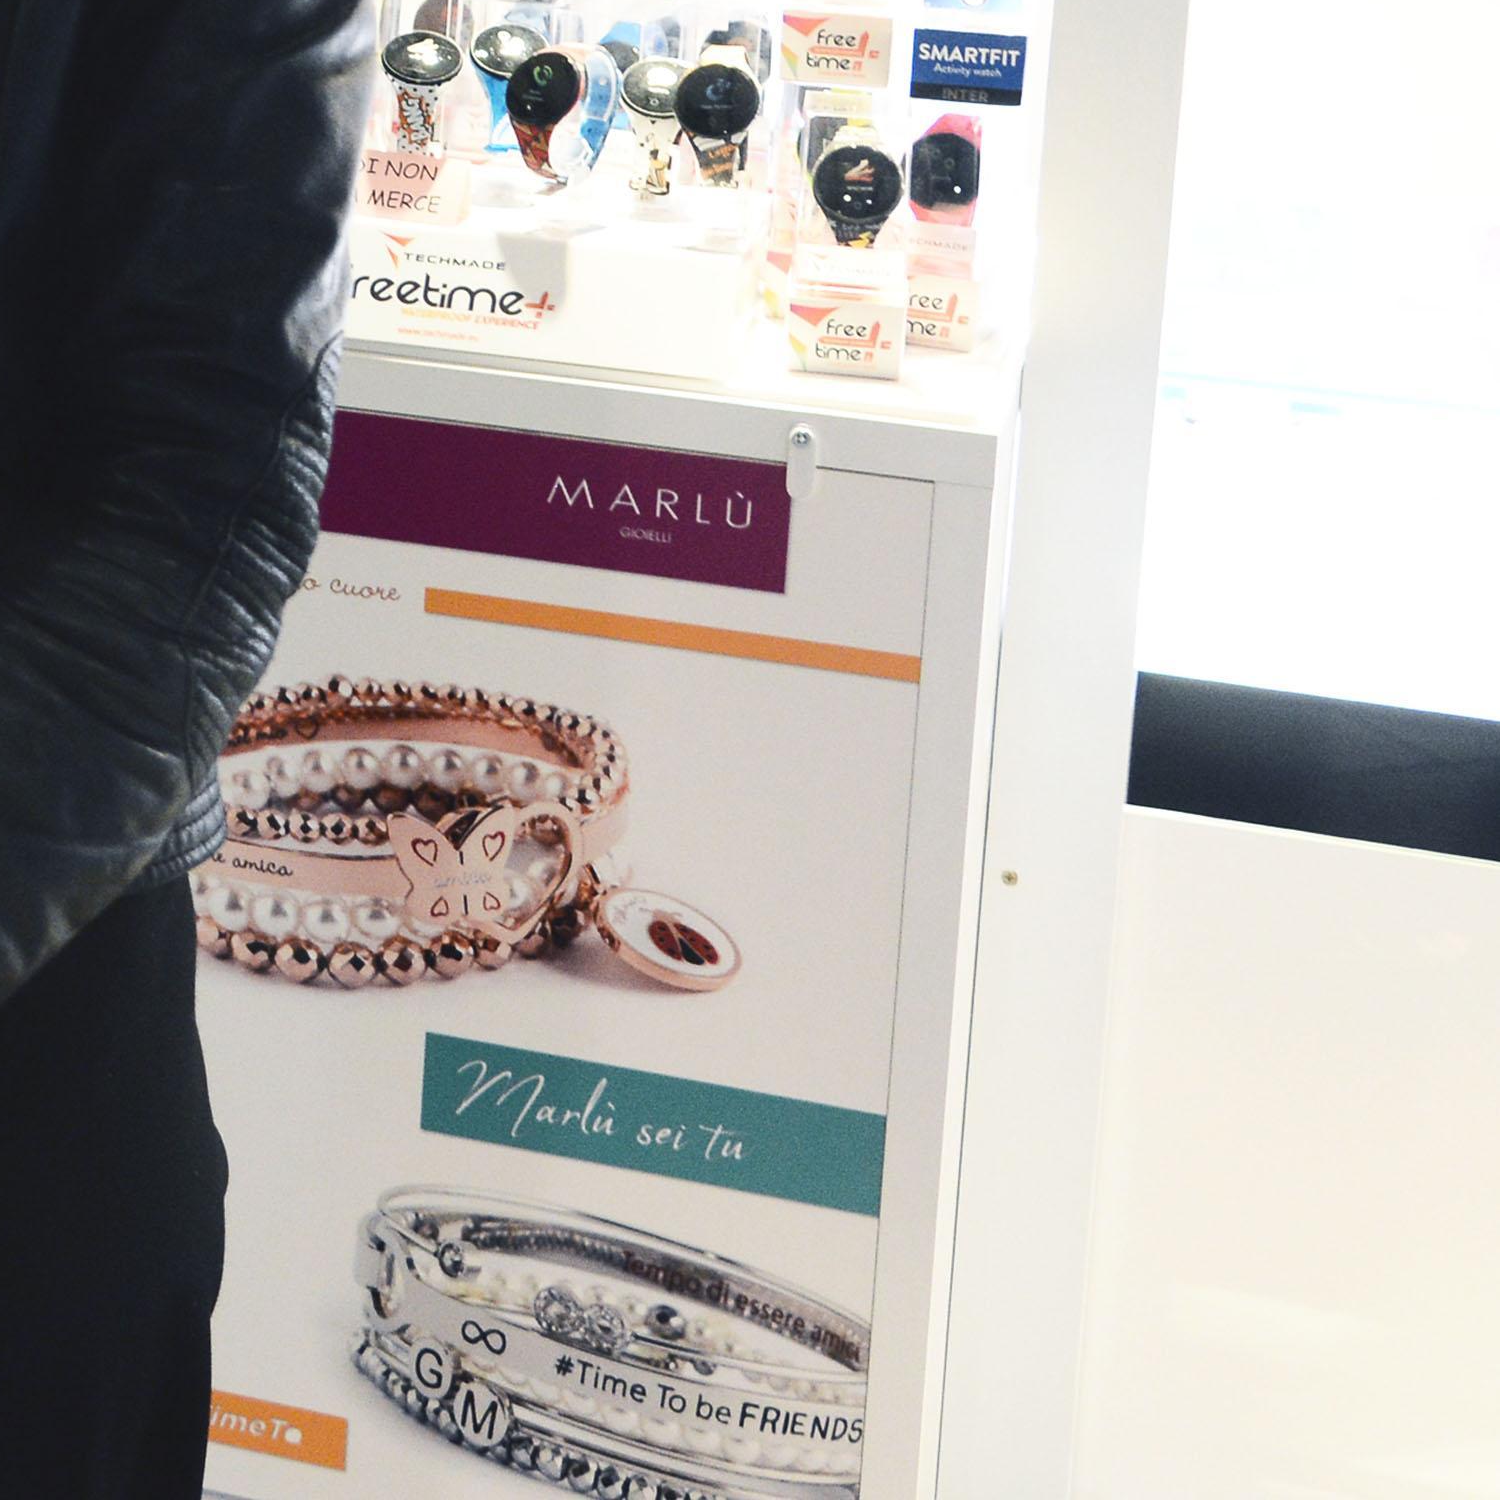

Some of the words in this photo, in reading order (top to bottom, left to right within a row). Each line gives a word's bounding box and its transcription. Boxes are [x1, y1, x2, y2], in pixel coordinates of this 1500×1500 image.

[816, 28, 858, 48] free
[806, 55, 852, 72] time
[919, 42, 1022, 67] SMARTFIT
[933, 63, 970, 78] Activity
[973, 67, 1003, 78] watch
[942, 86, 990, 102] INTER
[384, 159, 439, 182] NON
[368, 189, 441, 214] MERCE
[404, 251, 507, 272] TECHMADE
[909, 293, 944, 311] ree
[826, 318, 868, 338] free
[815, 342, 862, 362] time
[547, 475, 753, 530] MARLÙ
[619, 526, 673, 544] GIOIELLI
[329, 578, 401, 601] cuore
[232, 857, 294, 877] amica
[456, 1059, 616, 1138] Marlù
[636, 1122, 686, 1151] sei
[698, 1124, 746, 1161] tu
[620, 1249, 698, 1295] Tempo
[706, 1280, 732, 1308] di
[738, 1295, 806, 1332] essere
[554, 1354, 648, 1403] #Time
[658, 1384, 687, 1415] To
[698, 1395, 732, 1426] be
[738, 1402, 865, 1444] FRIENDS
